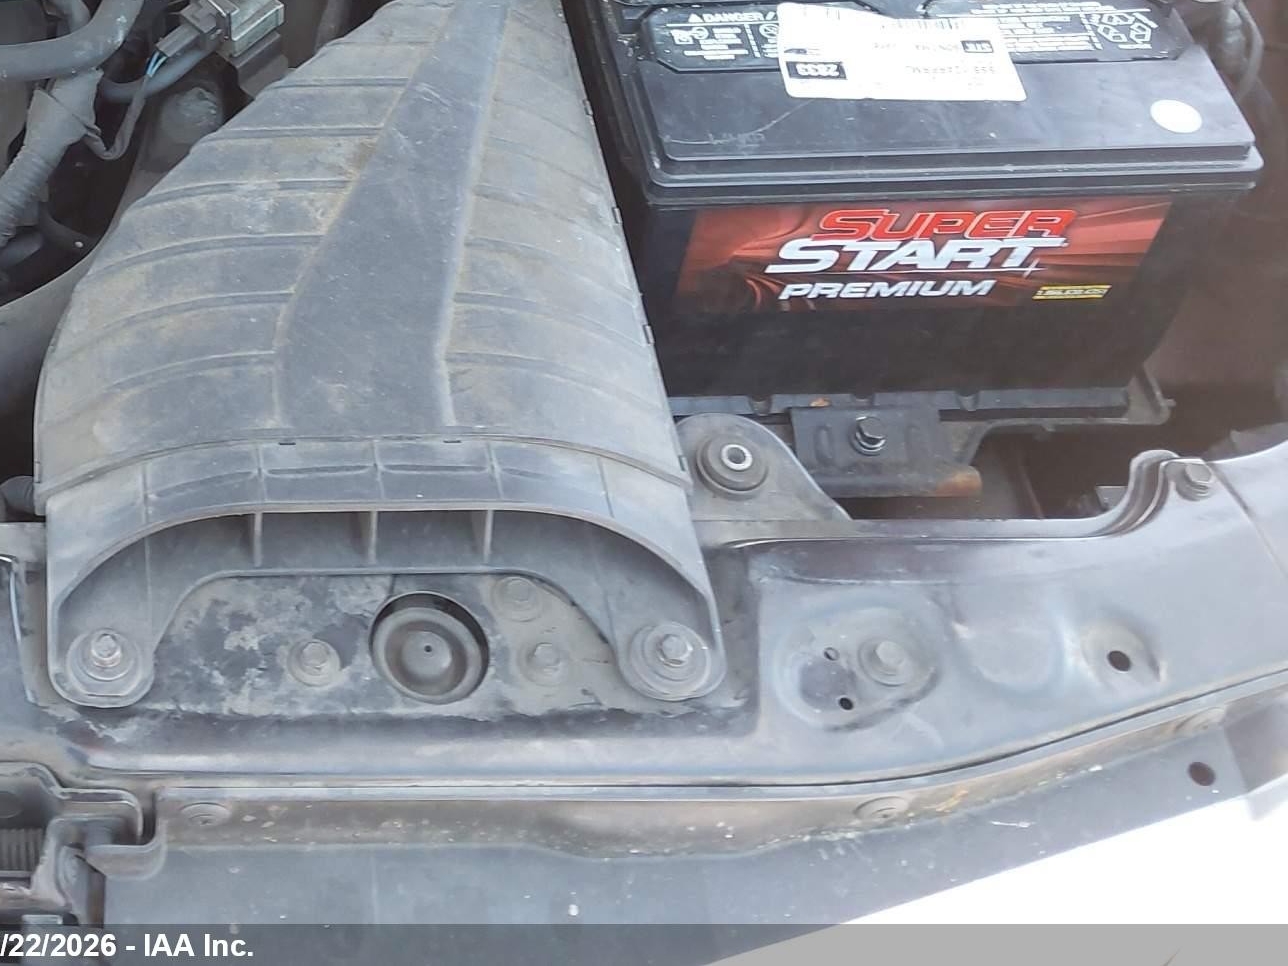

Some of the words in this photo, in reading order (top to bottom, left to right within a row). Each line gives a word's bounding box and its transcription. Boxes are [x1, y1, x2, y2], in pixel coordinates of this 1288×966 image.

[811, 209, 1076, 241] SUPER
[764, 237, 1068, 274] START
[778, 280, 997, 300] PREMIUM
